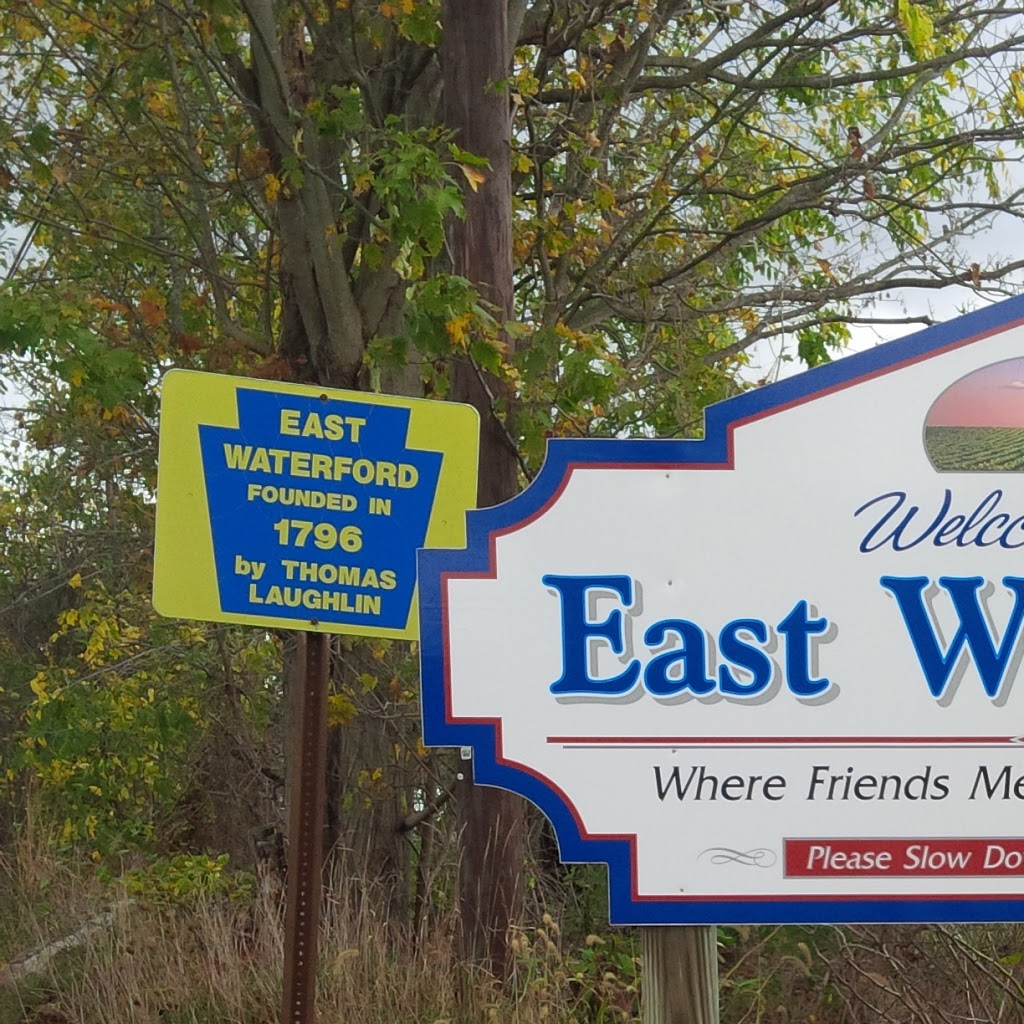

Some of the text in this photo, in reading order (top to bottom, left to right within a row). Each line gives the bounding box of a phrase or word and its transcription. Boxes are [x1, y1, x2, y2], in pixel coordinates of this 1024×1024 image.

[280, 409, 365, 443] EAST
[223, 443, 418, 488] WATERFORD
[247, 484, 391, 515] FOUNDED IN
[274, 519, 363, 552] 1796
[234, 555, 397, 590] by THOMAS
[249, 584, 381, 615] LAUGHLIN
[542, 574, 840, 706] East
[653, 765, 786, 801] Where
[806, 765, 950, 801] Friends
[806, 845, 892, 871] Please
[903, 845, 972, 871] Slow
